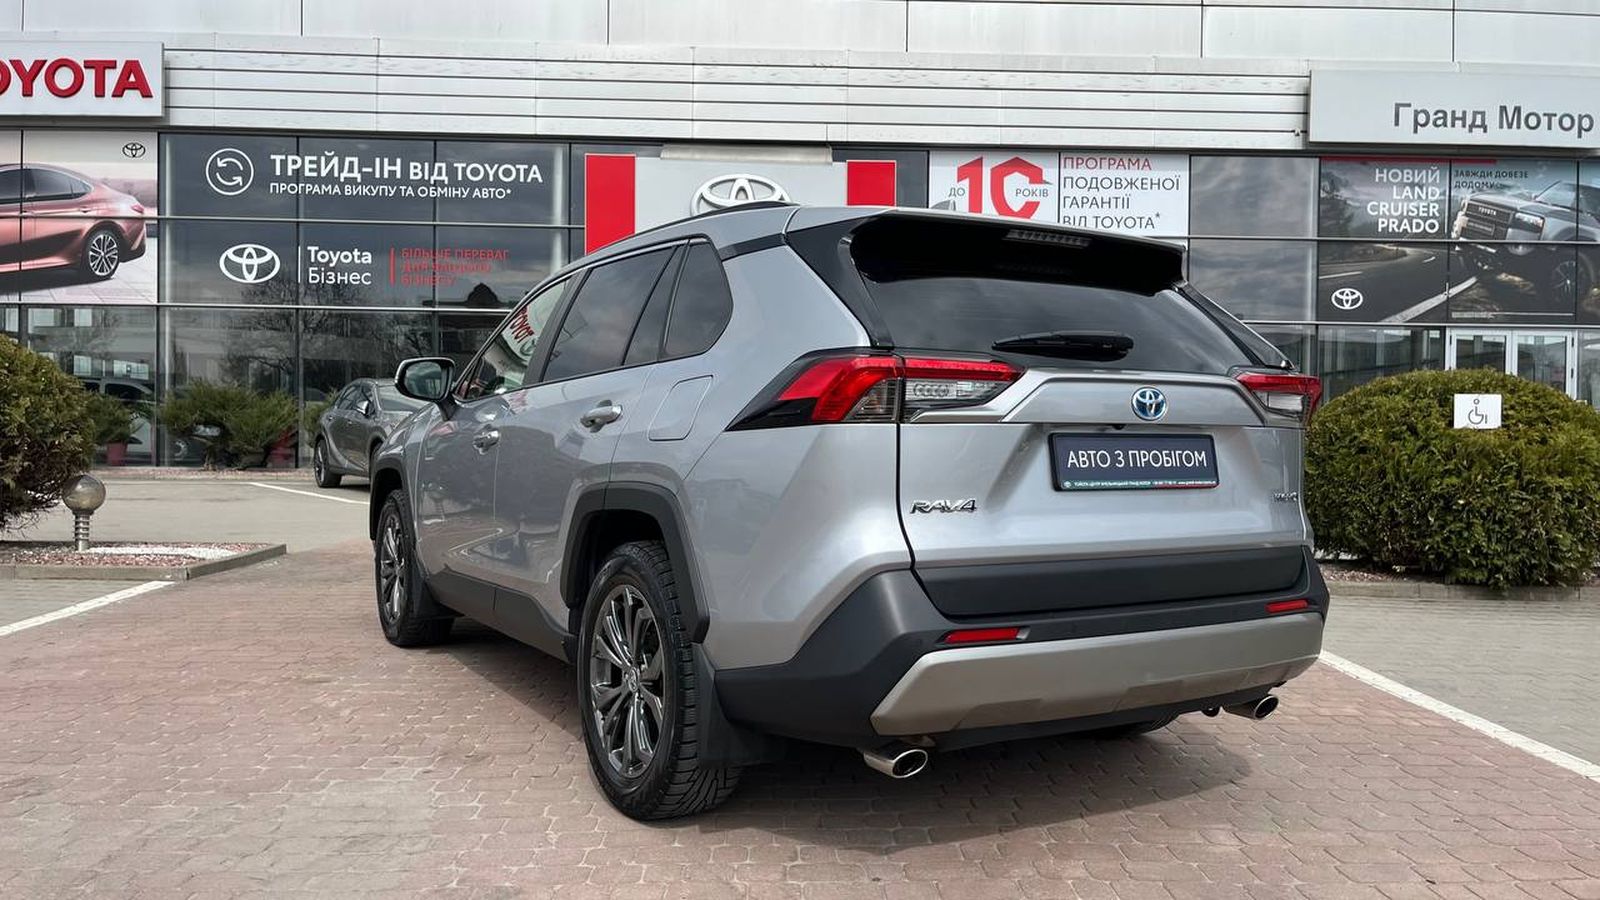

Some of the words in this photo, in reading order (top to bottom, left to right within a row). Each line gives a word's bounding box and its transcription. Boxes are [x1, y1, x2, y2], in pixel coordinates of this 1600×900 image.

[0, 58, 153, 98] YOTA
[1394, 103, 1488, 134] Гранд
[1499, 105, 1594, 139] Мотор
[270, 150, 401, 183] ТРЕЙД-ІН
[409, 161, 449, 185] ВІД
[453, 163, 543, 183] TOYOTA
[1063, 156, 1152, 170] ПРОГРАМА
[1375, 166, 1440, 183] НОВИЙ
[269, 182, 341, 196] ПРОГРАМА
[344, 184, 396, 197] ВИКУПУ
[400, 186, 414, 197] ТА
[417, 186, 470, 198] ОБМІНУ
[1063, 175, 1181, 192] ПОДОВЖЕНОЇ
[948, 187, 966, 198] ДО
[1015, 188, 1049, 198] РОКІВ
[1393, 186, 1440, 200] LAND
[1063, 193, 1132, 209] ГАРАНТІЇ
[1367, 201, 1440, 217] CRUISER
[1378, 218, 1440, 233] PRADO
[307, 246, 372, 267] Toyota
[308, 267, 372, 285] Бізнес
[1067, 450, 1111, 468] АВТО
[1129, 450, 1207, 468] ПРОБІГОМ
[910, 498, 977, 514] RAV4
